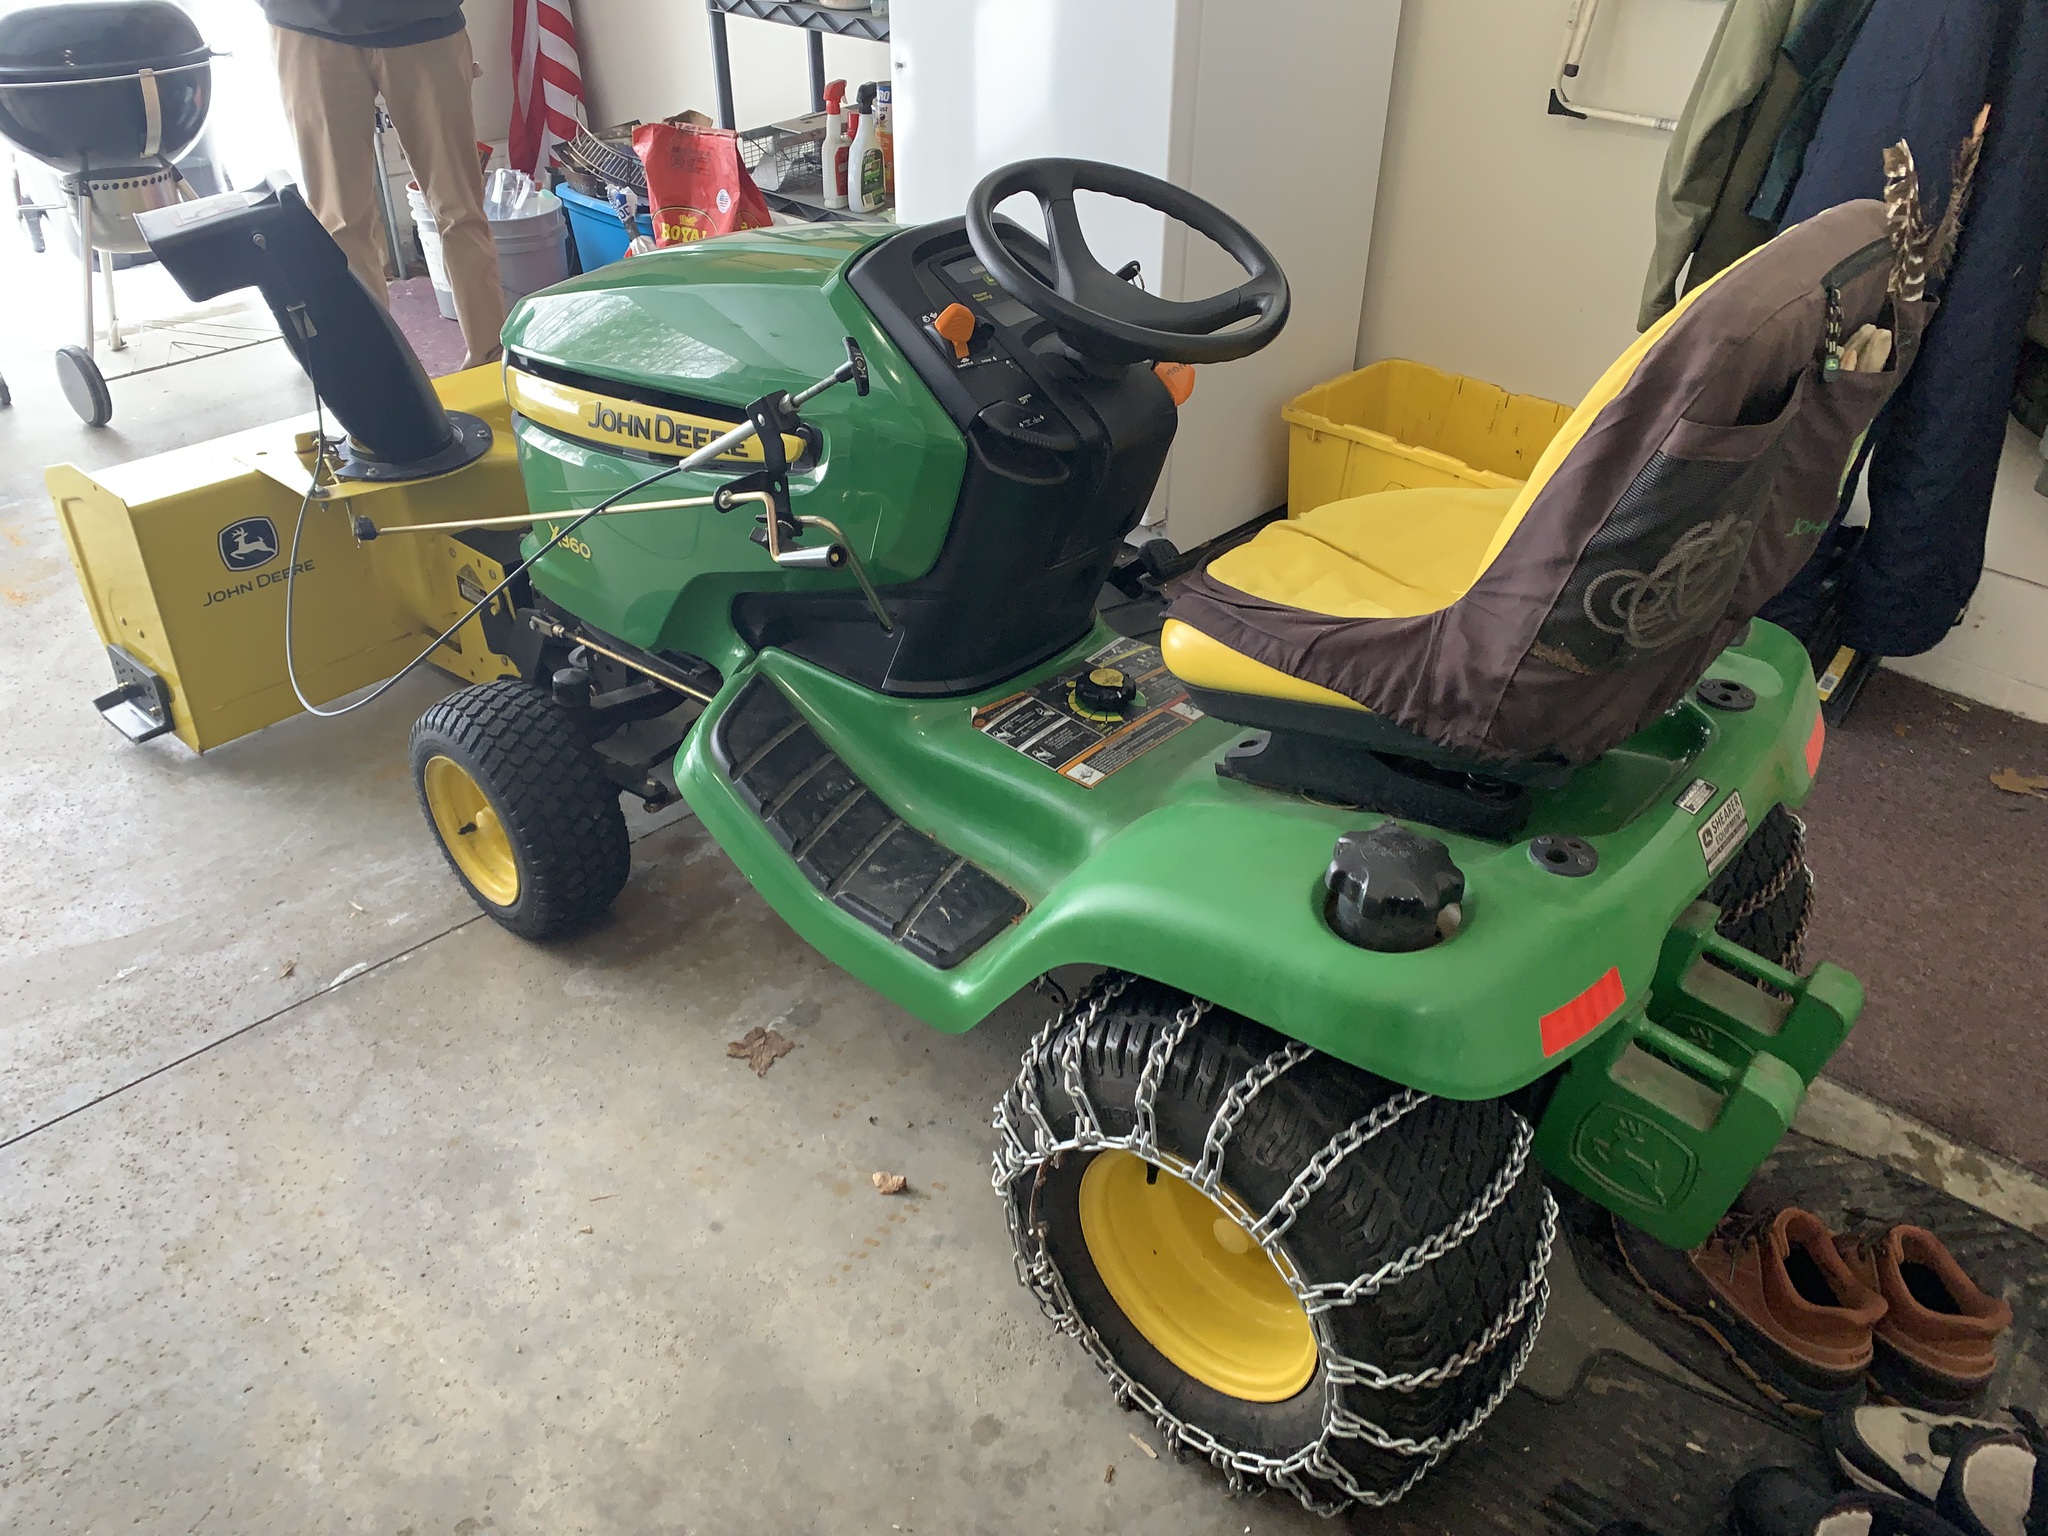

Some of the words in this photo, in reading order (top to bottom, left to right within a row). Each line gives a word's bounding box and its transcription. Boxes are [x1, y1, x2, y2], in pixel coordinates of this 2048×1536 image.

[588, 401, 651, 440] JOHN
[547, 520, 591, 559] X360
[203, 581, 253, 607] JOHN
[256, 559, 315, 588] DEERE
[1711, 795, 1740, 834] SHEARER
